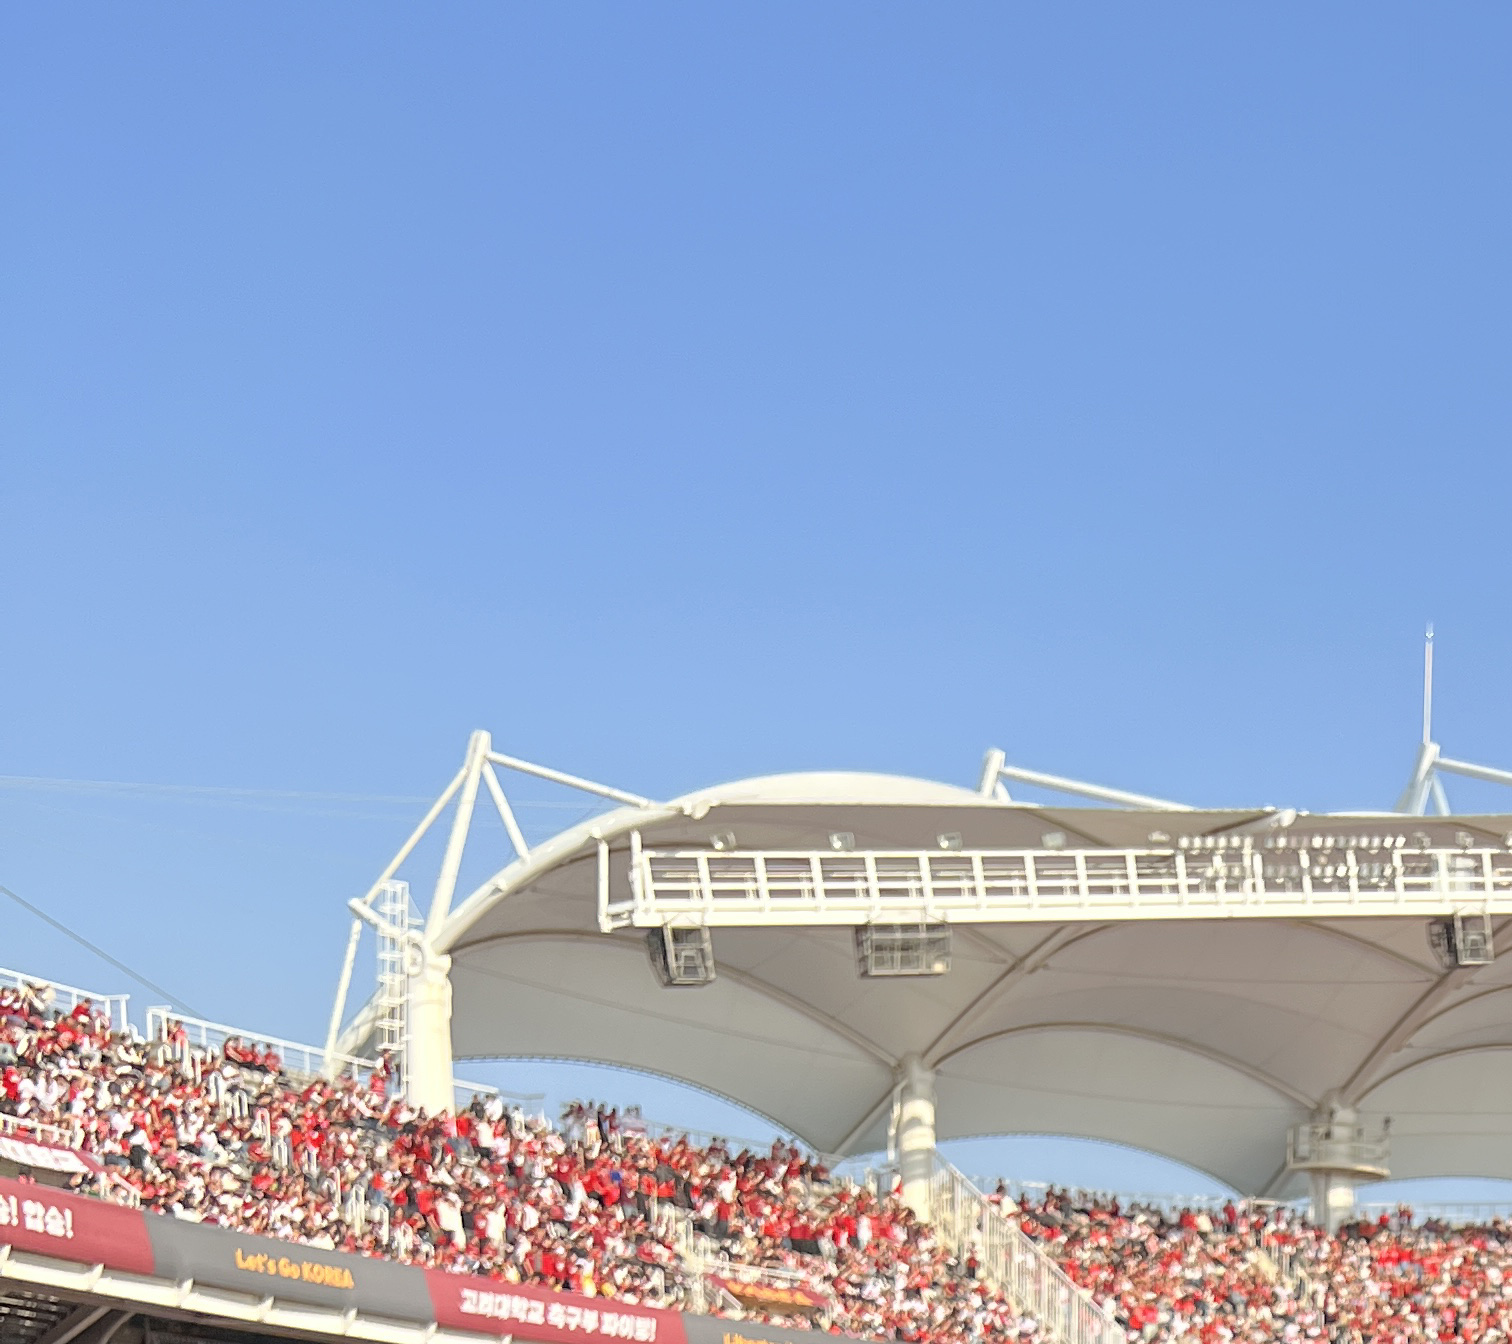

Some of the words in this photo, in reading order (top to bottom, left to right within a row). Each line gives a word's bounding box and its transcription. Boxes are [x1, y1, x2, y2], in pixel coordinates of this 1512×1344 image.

[278, 1257, 300, 1279] Go
[301, 1261, 355, 1289] KOREA
[460, 1288, 545, 1325] 고려대학교
[547, 1302, 599, 1333] 축구부
